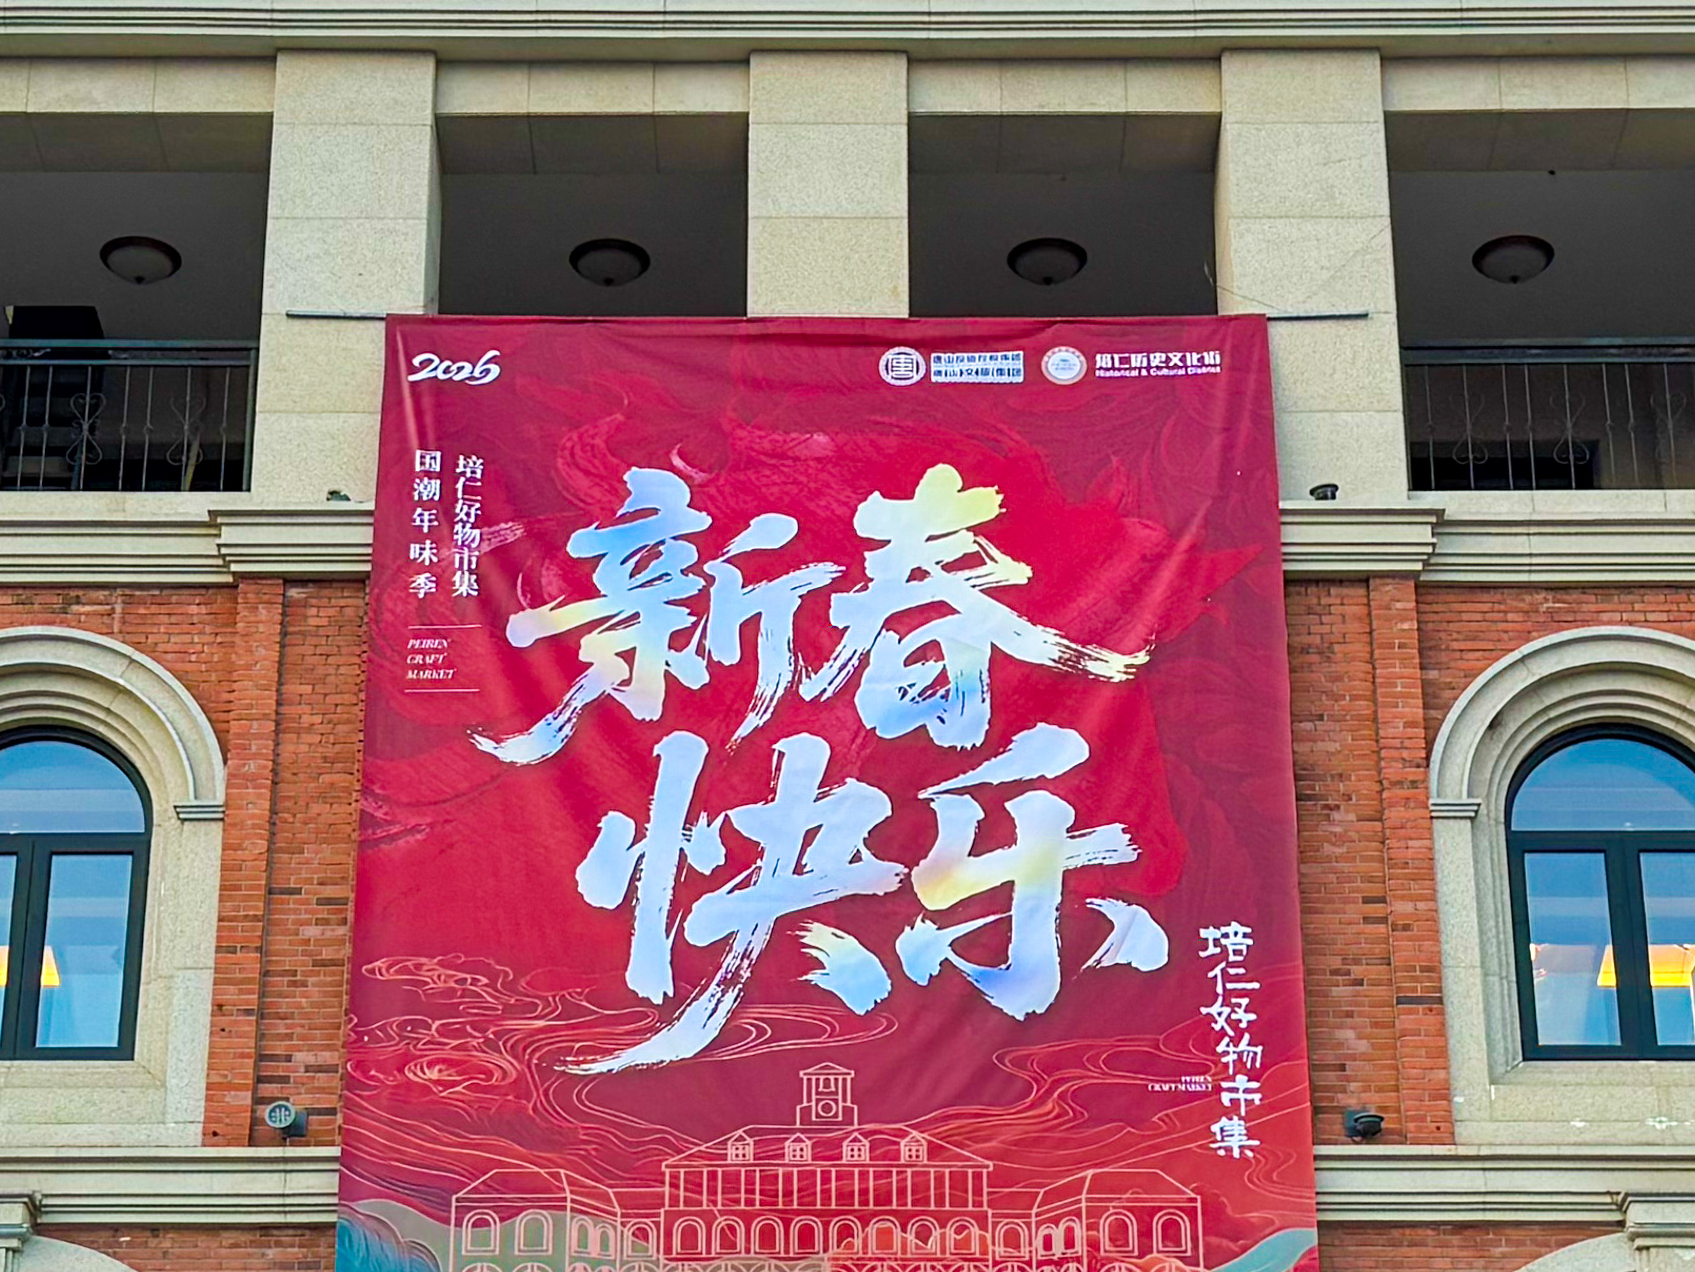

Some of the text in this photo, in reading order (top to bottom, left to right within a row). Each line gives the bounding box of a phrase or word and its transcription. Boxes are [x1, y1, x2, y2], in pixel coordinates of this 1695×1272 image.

[407, 349, 501, 385] 2026
[408, 449, 442, 599] 国潮年味季
[451, 454, 484, 598] 培仁好物市集
[406, 638, 450, 649] PEIREN
[406, 653, 446, 664] CRAFT
[406, 668, 456, 680] MARKET
[469, 463, 1155, 766] 新春
[551, 724, 1169, 1075] 快乐
[1198, 921, 1263, 1159] 培仁好物市集
